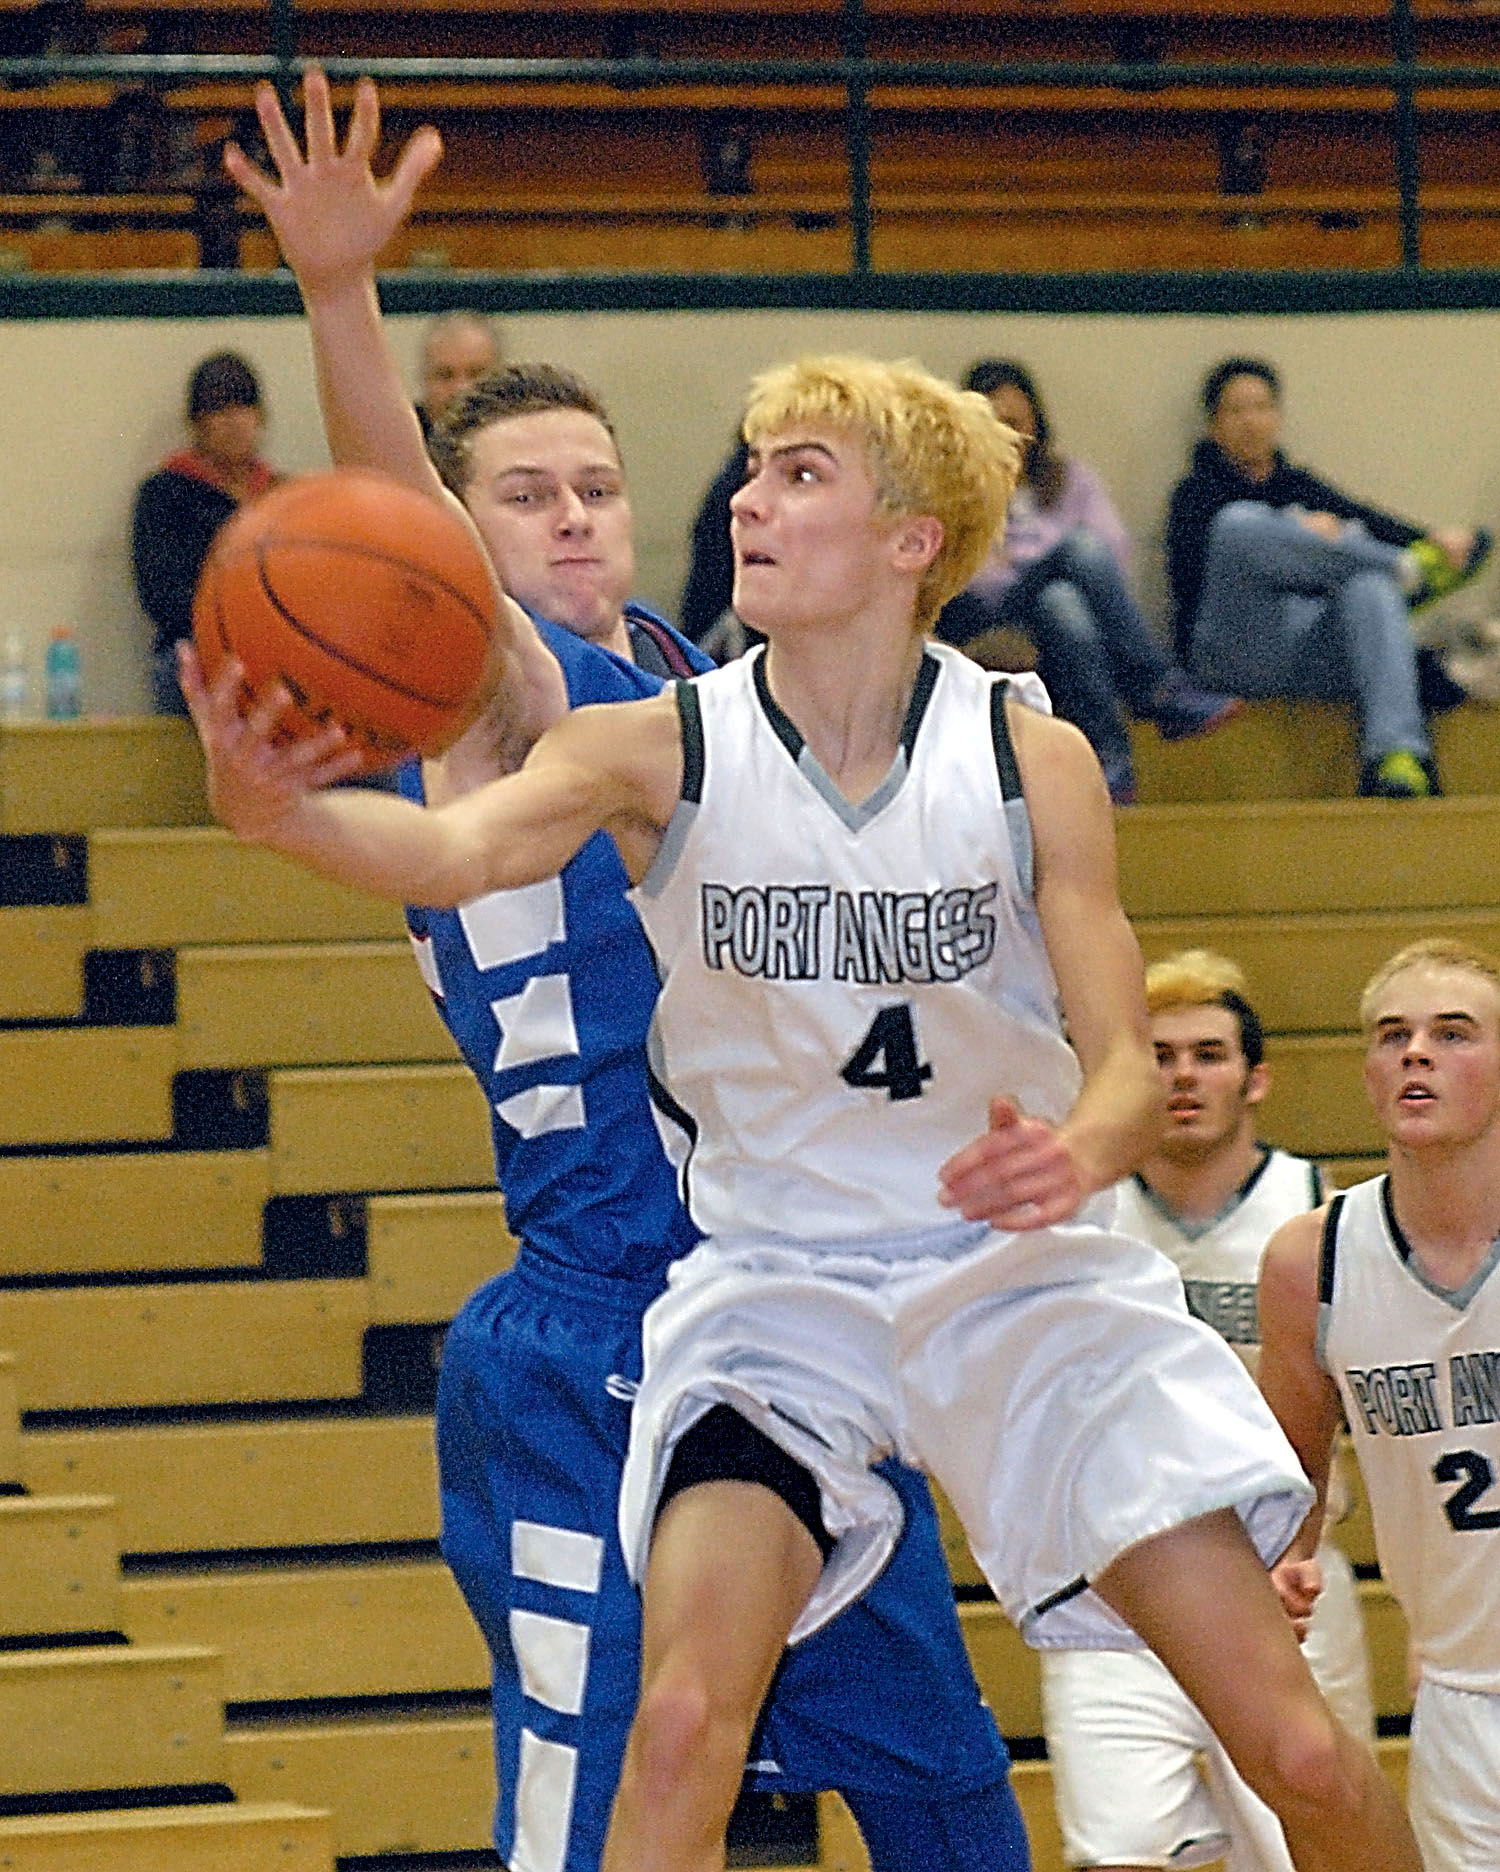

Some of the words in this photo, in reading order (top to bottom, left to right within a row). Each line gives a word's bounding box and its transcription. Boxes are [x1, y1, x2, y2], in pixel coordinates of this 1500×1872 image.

[702, 883, 829, 980] PORT
[834, 881, 997, 983] ANGEES
[840, 1003, 933, 1101] 4
[1345, 1362, 1442, 1436] PORT
[1431, 1449, 1500, 1531] 2
